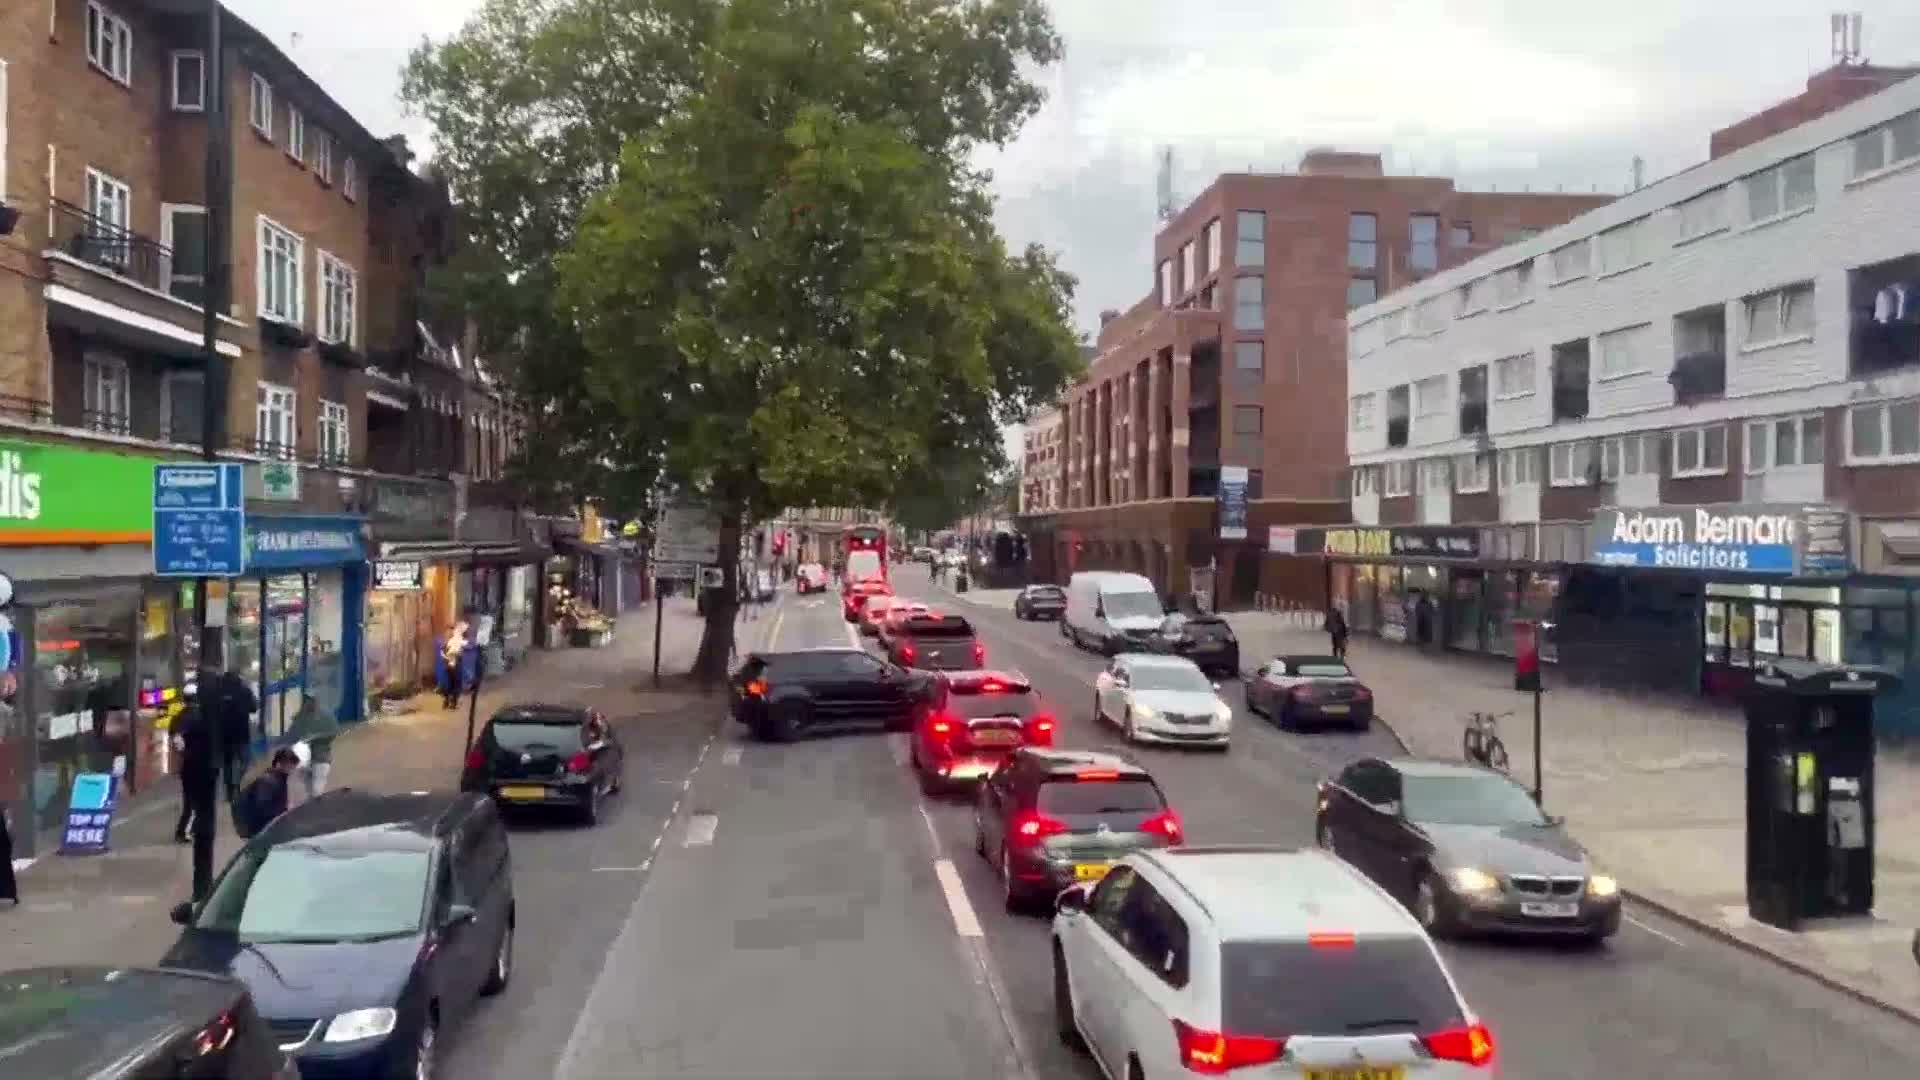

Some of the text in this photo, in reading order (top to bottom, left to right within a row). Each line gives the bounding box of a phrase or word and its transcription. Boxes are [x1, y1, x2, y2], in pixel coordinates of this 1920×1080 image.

[1613, 512, 1683, 543] Adam
[1654, 544, 1748, 568] Solicitors
[69, 813, 93, 826] TOP
[67, 828, 104, 842] HERE
